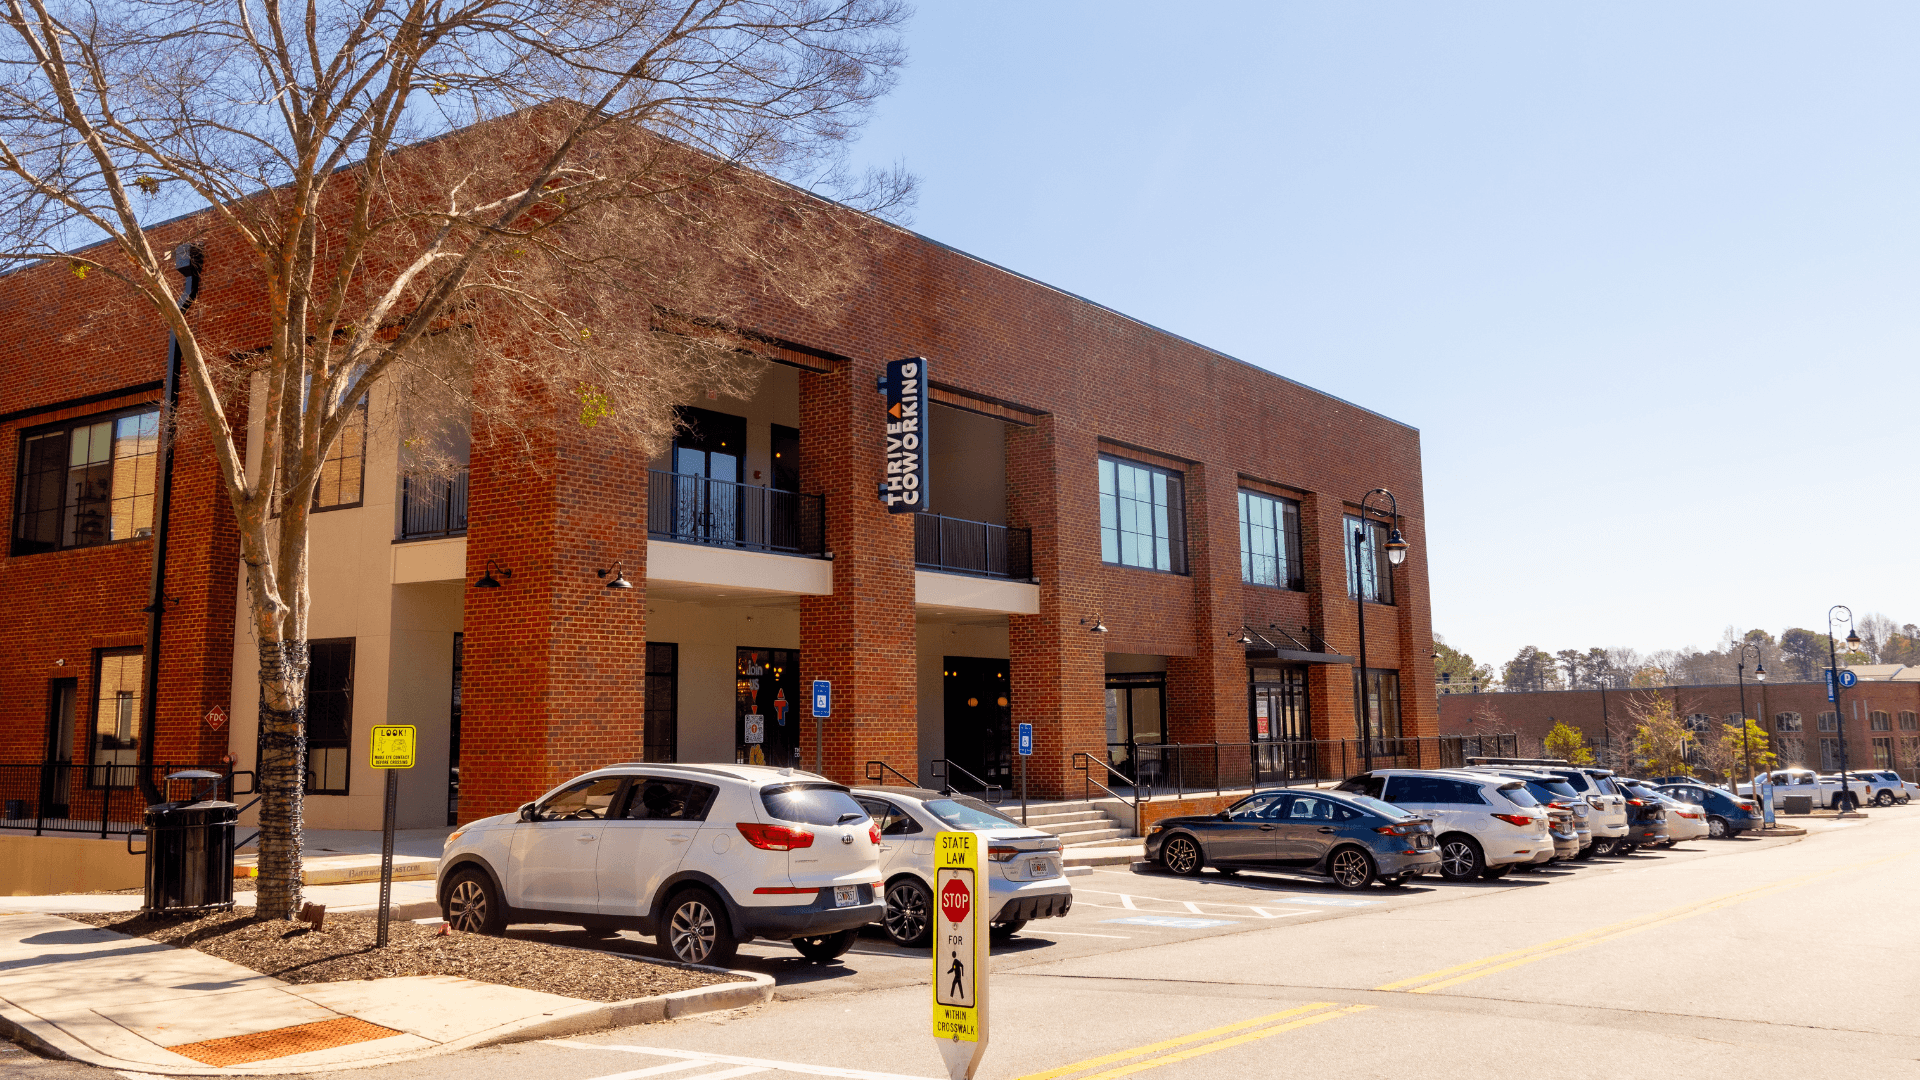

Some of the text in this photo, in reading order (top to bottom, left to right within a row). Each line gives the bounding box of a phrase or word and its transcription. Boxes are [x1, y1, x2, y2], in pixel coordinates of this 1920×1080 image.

[901, 362, 919, 505] COWORKING
[887, 421, 903, 506] THRIVE
[1844, 673, 1851, 685] P
[209, 713, 224, 721] FDC
[381, 729, 407, 737] LOOK!
[942, 836, 970, 849] STATE
[946, 852, 965, 865] LAW
[943, 892, 969, 909] STOP
[948, 935, 963, 946] FOR
[944, 1009, 967, 1021] WITHIN
[937, 1021, 975, 1036] CROSSWALK
